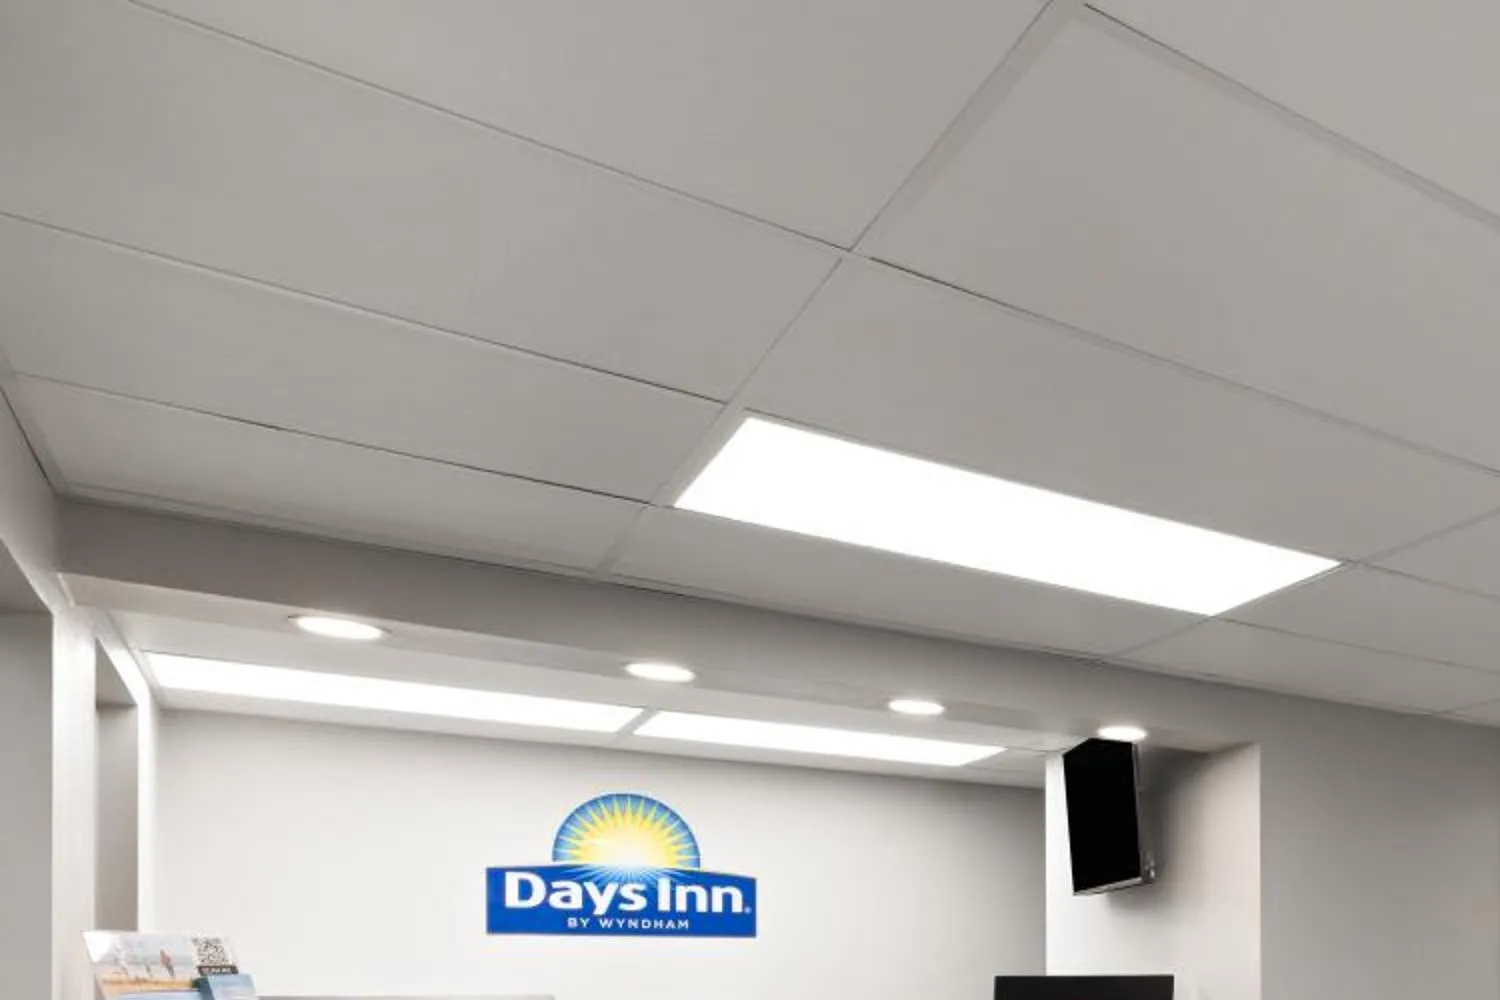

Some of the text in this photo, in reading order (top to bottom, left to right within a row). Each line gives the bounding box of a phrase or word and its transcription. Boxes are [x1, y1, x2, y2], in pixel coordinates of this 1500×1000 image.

[504, 871, 743, 915] Days Inn
[567, 917, 690, 930] BY WYNDHAM
